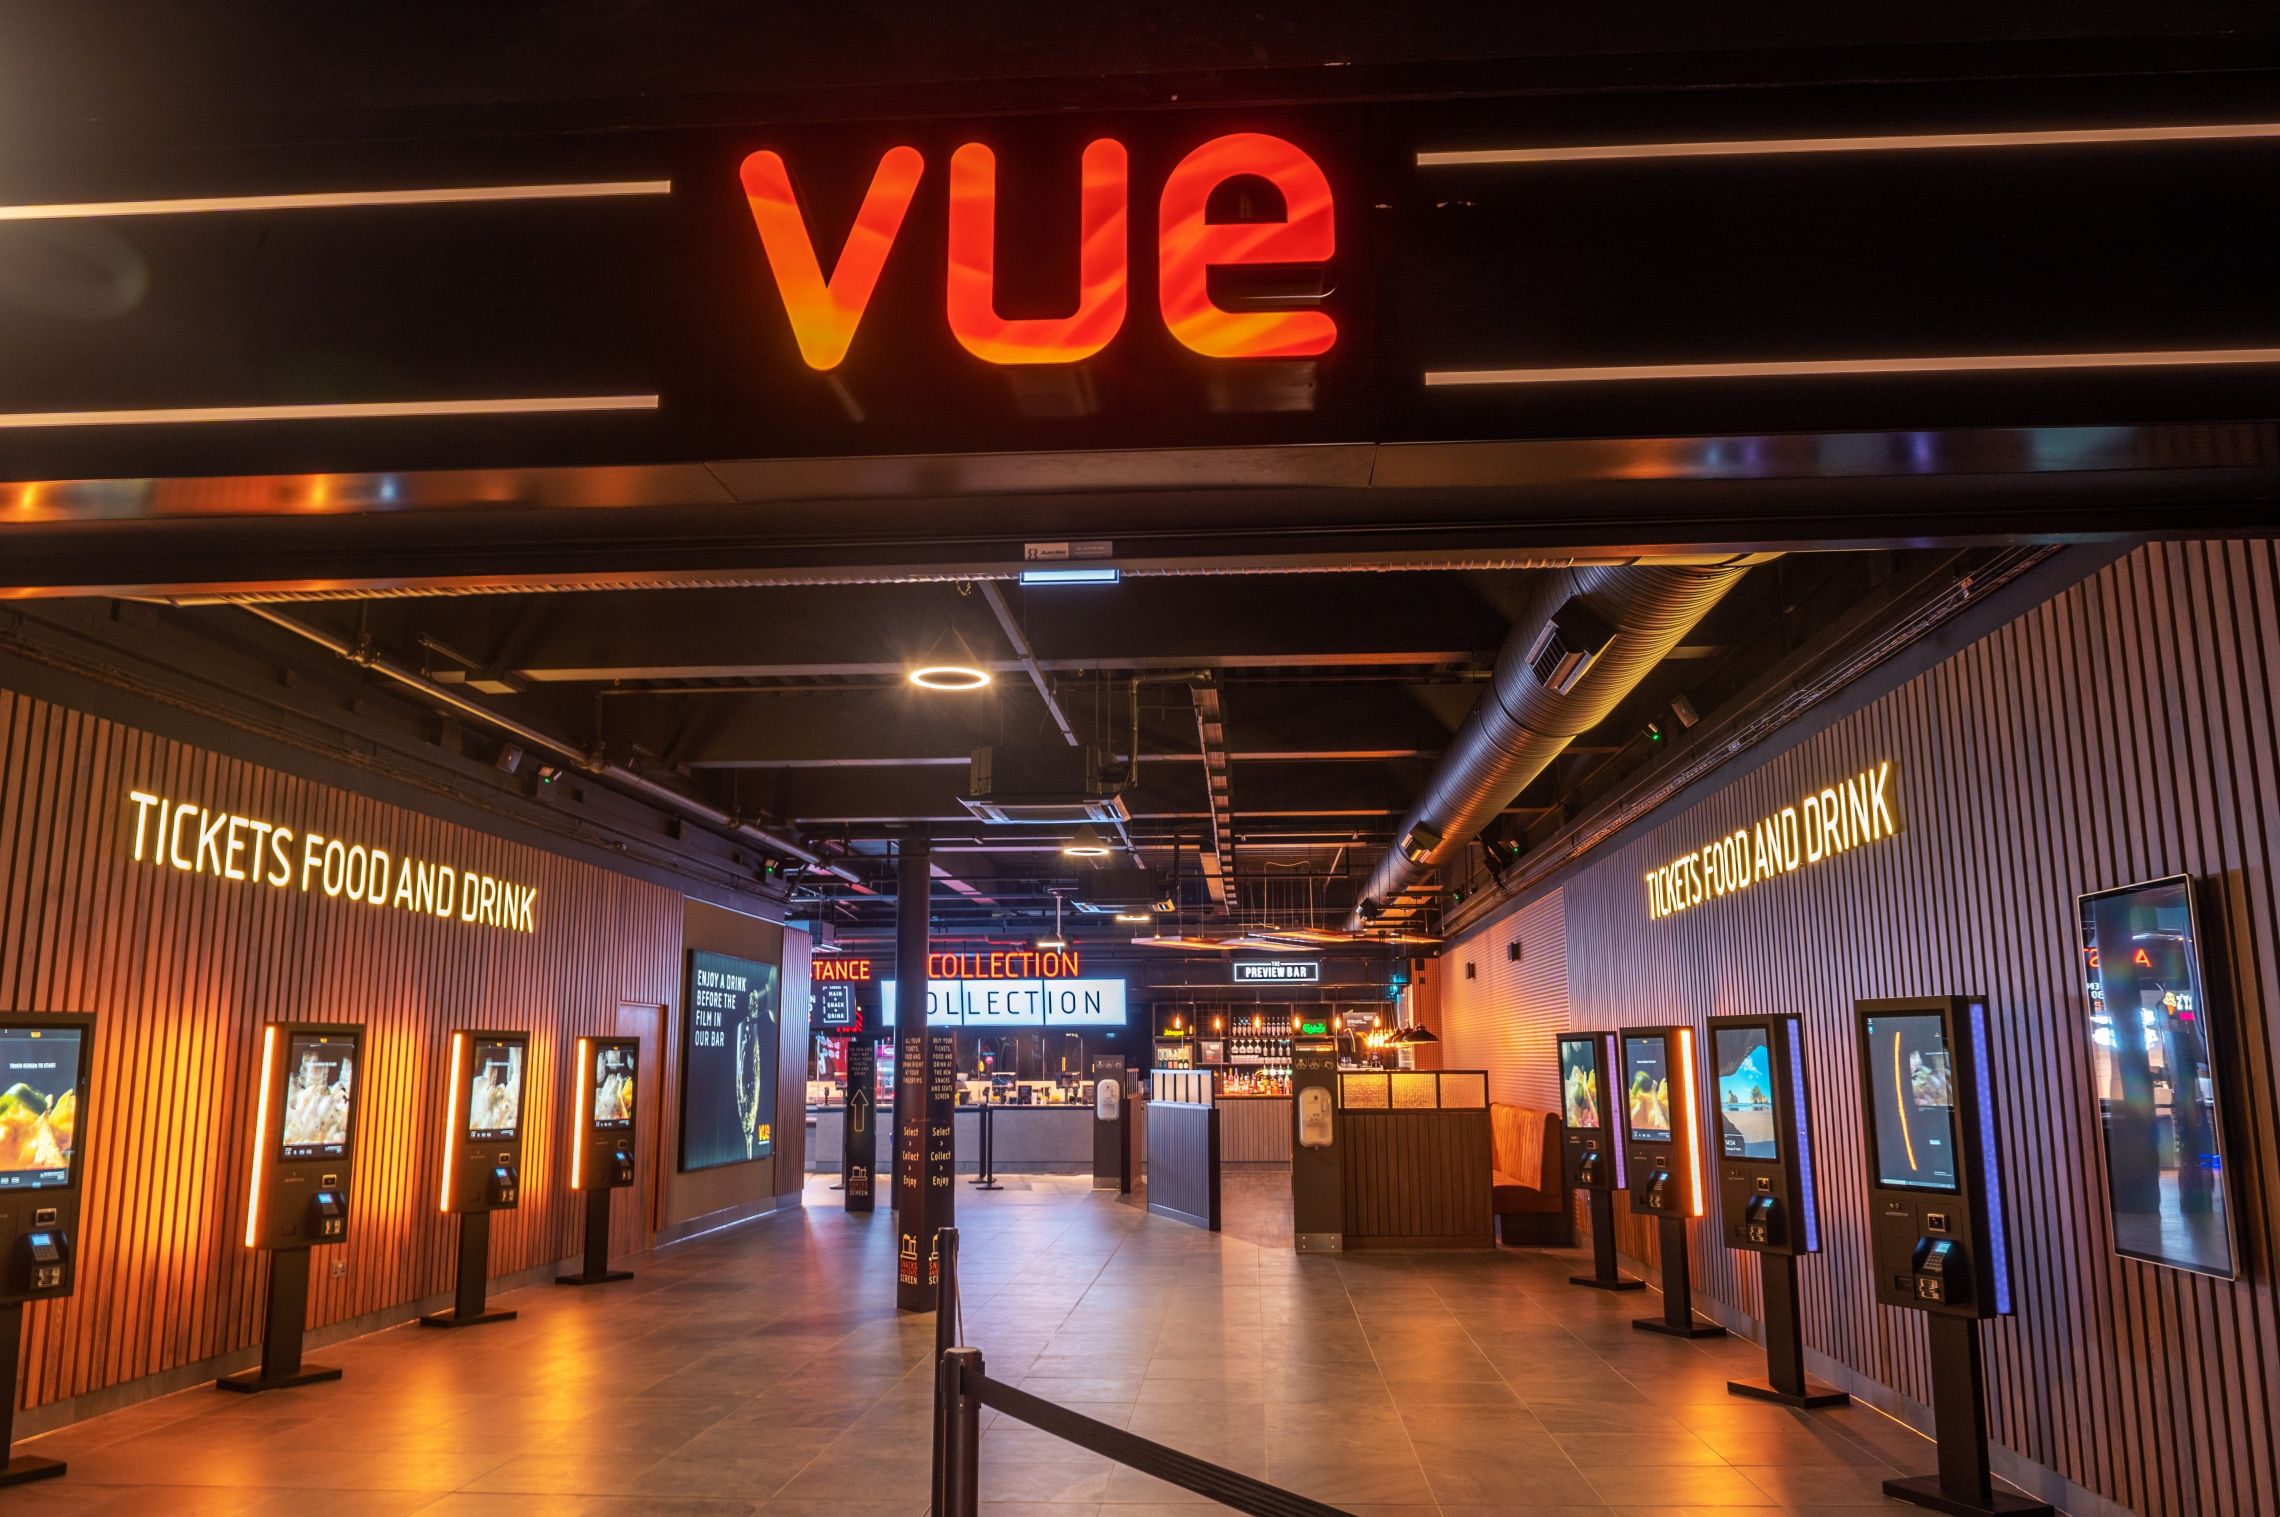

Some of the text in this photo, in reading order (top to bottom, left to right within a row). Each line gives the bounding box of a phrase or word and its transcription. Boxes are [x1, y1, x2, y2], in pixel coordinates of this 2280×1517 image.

[1647, 762, 1893, 920] TICKETS FOOD AND DRINK
[130, 791, 538, 934] TICKETS FOOD AND DRINK
[810, 960, 870, 980] TANCE
[928, 951, 1079, 978] COLLECTION
[1245, 966, 1307, 978] PREVIEW BAR
[697, 969, 747, 992] ENJOY A DRINK
[697, 990, 736, 1010] BEFORE THE
[927, 991, 1101, 1015] OLLECTION
[695, 1009, 722, 1027] FILM IN
[694, 1030, 725, 1047] OUR BAR
[903, 1126, 919, 1137] Select
[932, 1126, 951, 1137] Select
[902, 1150, 919, 1161] Collect
[930, 1150, 951, 1161] Collect
[903, 1174, 917, 1188] Enjoy
[932, 1175, 949, 1187] Enjoy
